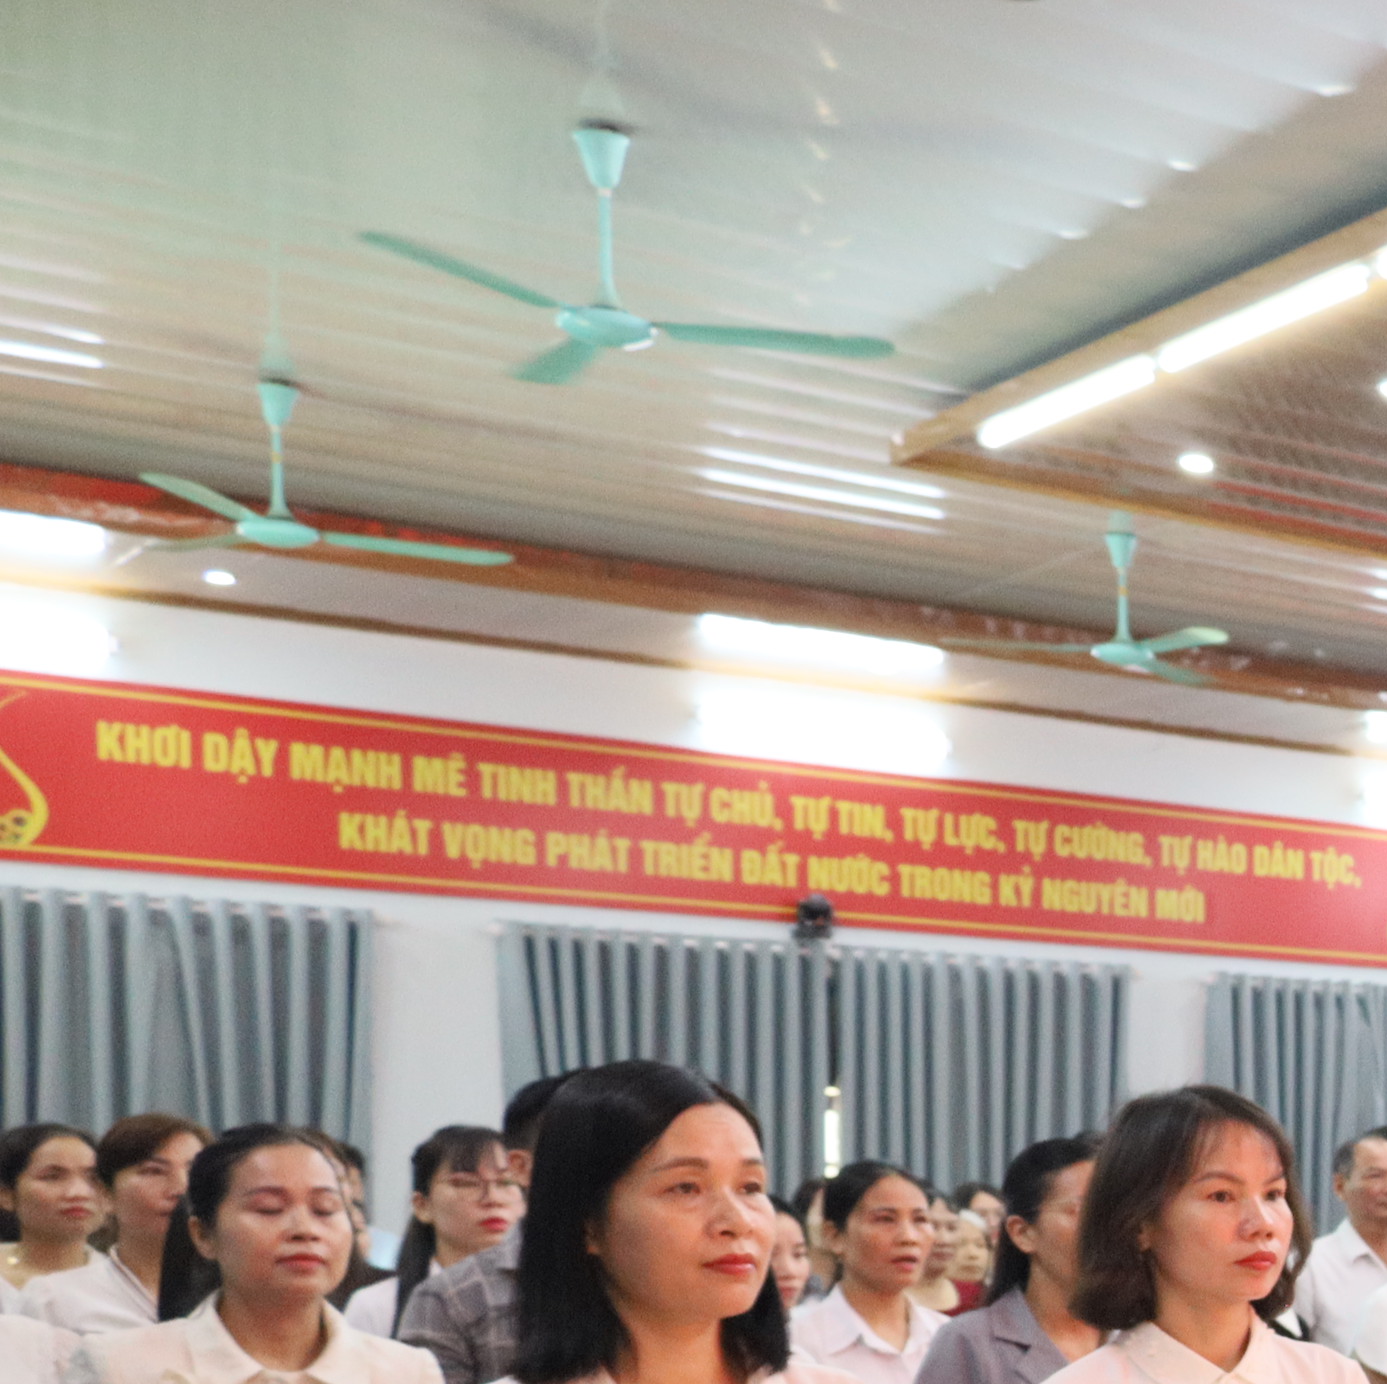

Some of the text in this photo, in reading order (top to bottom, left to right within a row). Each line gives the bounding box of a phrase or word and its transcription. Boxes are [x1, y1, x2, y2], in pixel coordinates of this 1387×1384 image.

[96, 719, 192, 769] KHƠI
[203, 727, 279, 784] DẬY
[289, 742, 402, 794] MẠNH
[477, 762, 557, 806] TINH
[661, 780, 704, 828] TỰ
[789, 796, 831, 840] TỰ
[836, 800, 894, 843] TIN,
[900, 807, 939, 850] TỰ
[944, 813, 1005, 855] LỰC,
[1012, 819, 1048, 861] TỰ
[1158, 835, 1192, 875] TỰ
[1197, 834, 1247, 875] HÀO
[1253, 841, 1304, 880] DÂN
[441, 821, 537, 869] VỌNG
[545, 829, 631, 874] PHÁT
[740, 841, 800, 888] ĐẤT
[807, 853, 890, 896] NƯỚC
[898, 863, 991, 905] TRONG
[1042, 877, 1148, 919] NGUYÊN
[1155, 884, 1206, 923] MỚI
